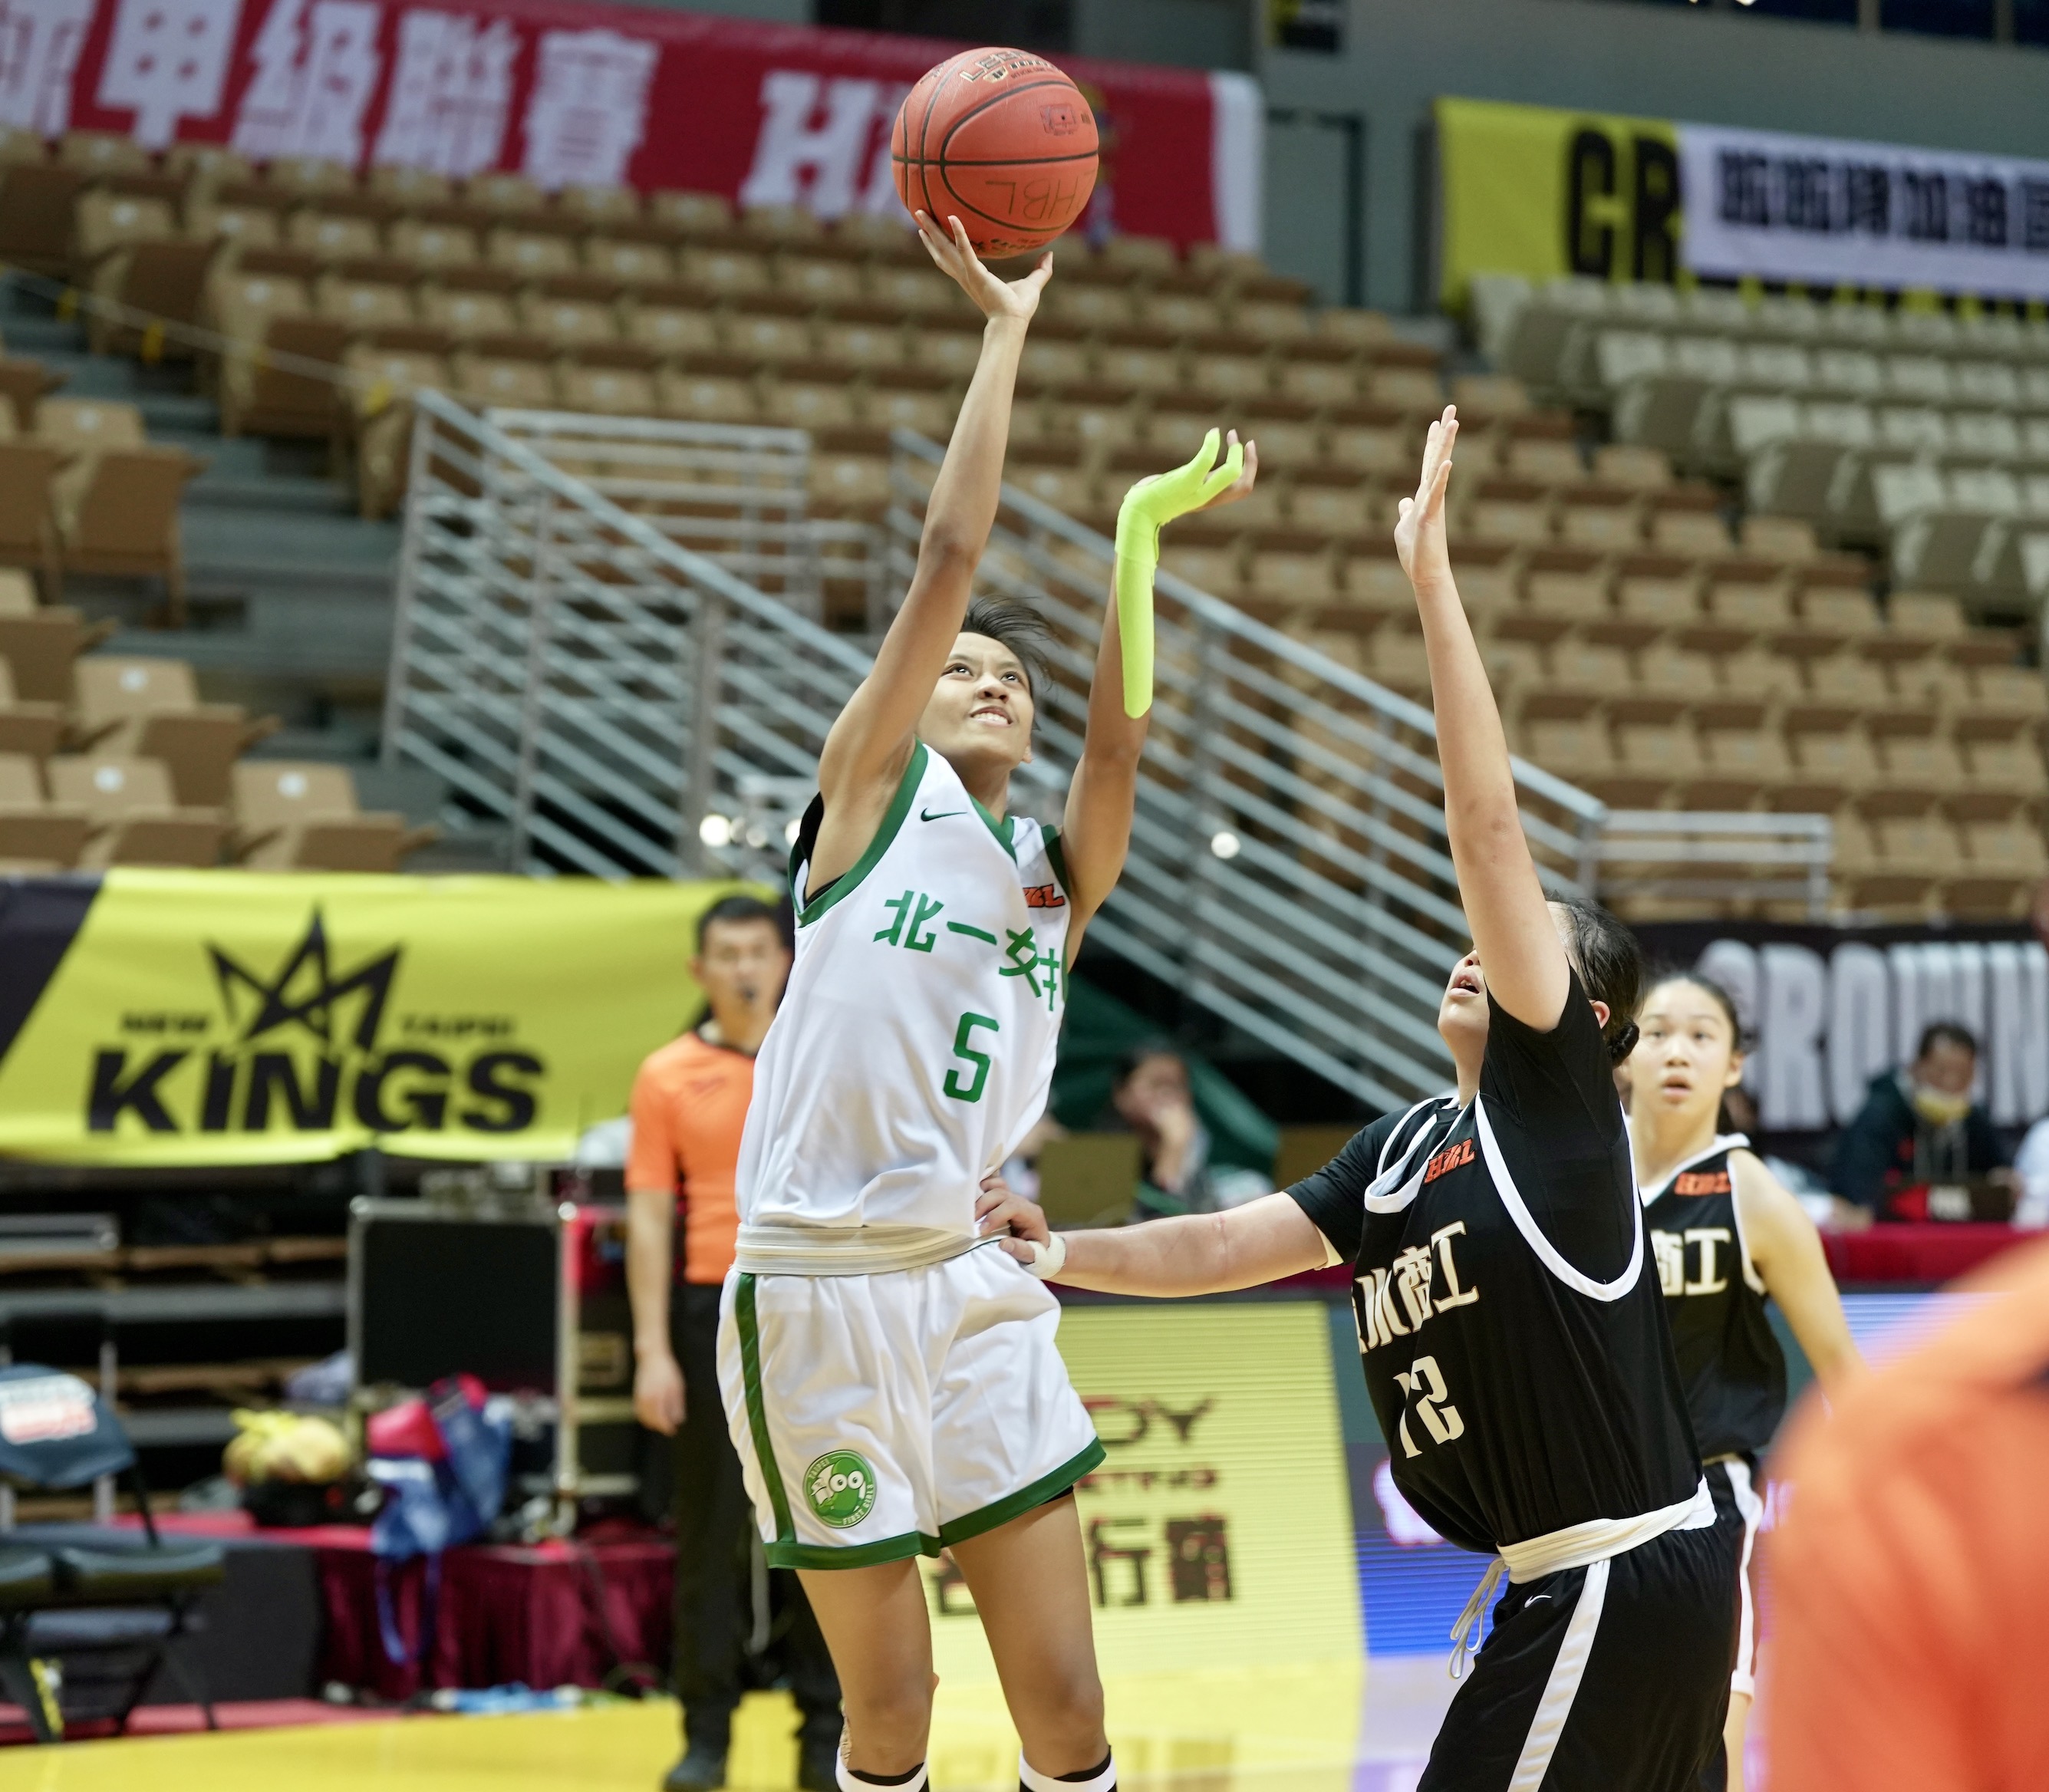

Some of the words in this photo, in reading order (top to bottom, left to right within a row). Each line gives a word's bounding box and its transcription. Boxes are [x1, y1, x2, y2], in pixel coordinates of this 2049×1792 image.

[985, 176, 1079, 221] HBL
[85, 1045, 548, 1134] KINGS
[943, 1012, 999, 1103] 5
[1351, 1220, 1480, 1356] 水商工
[1392, 1355, 1465, 1459] 12
